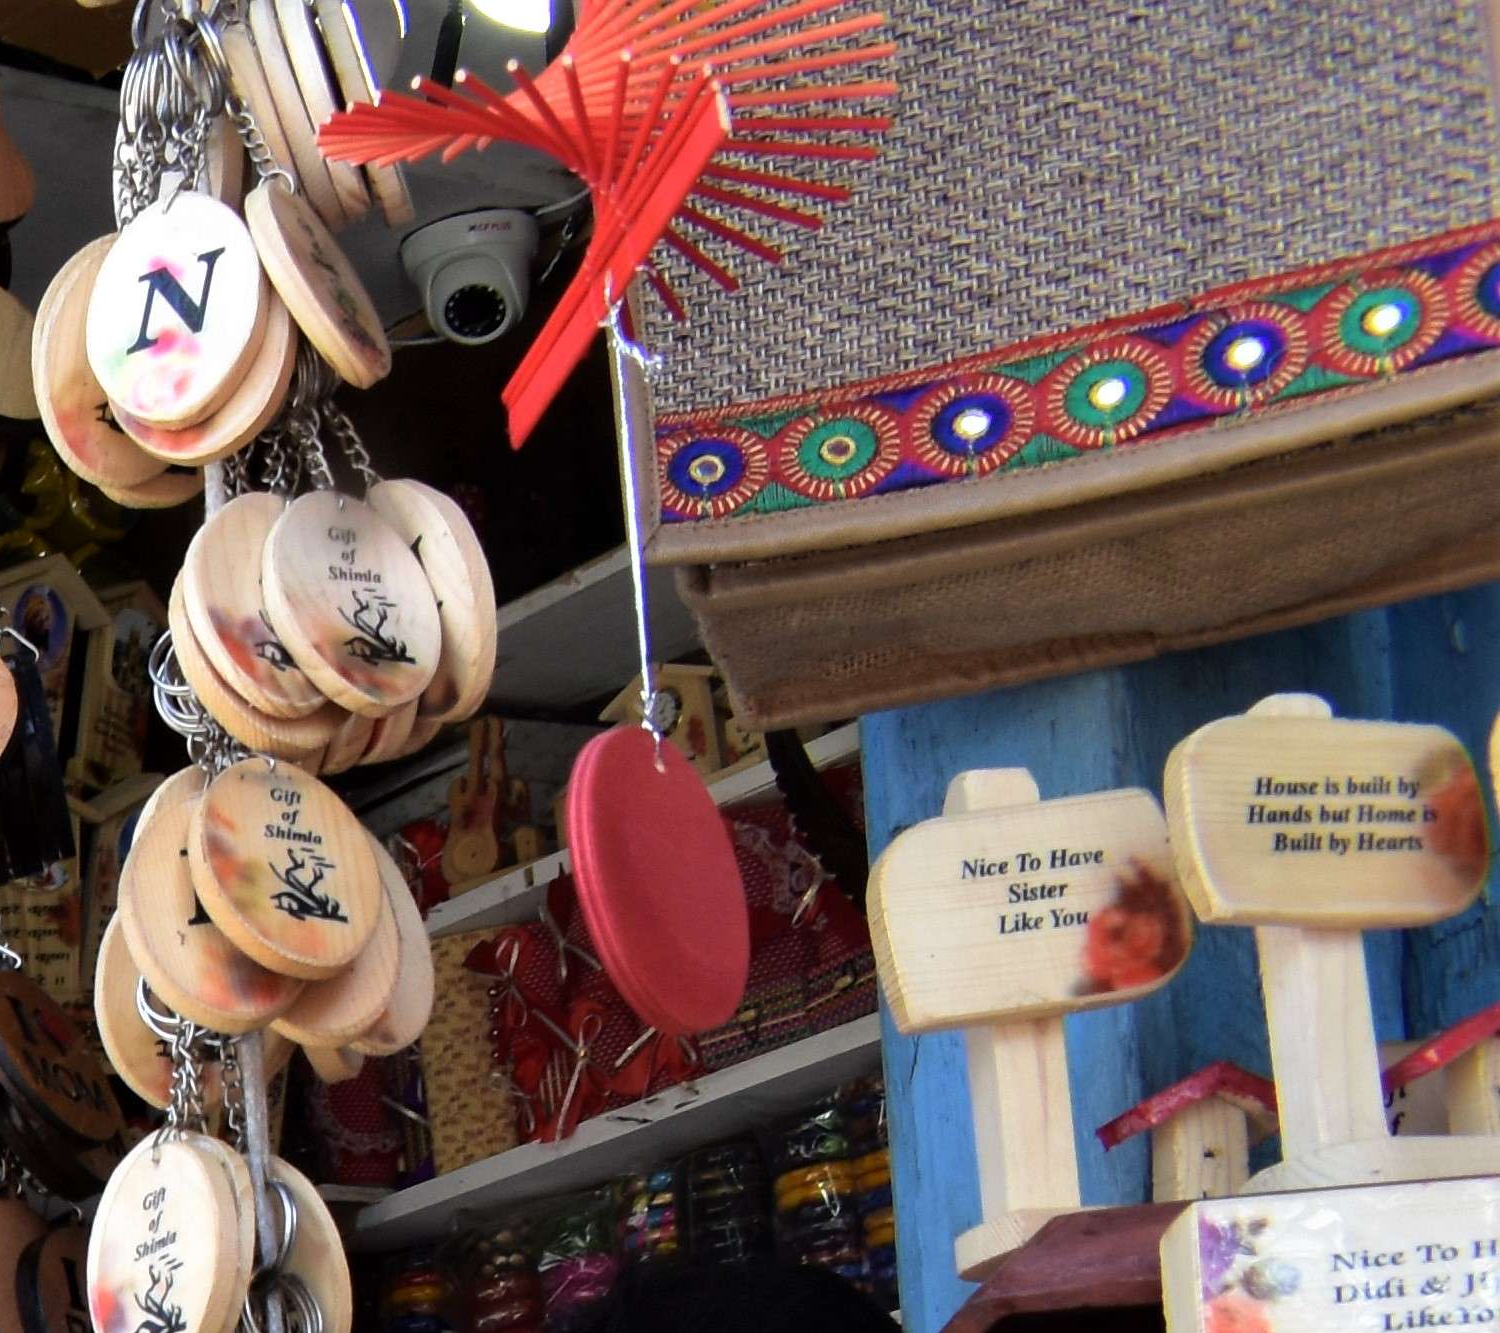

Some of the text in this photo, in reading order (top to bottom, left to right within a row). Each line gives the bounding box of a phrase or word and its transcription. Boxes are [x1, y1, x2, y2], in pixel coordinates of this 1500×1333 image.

[126, 246, 227, 356] N
[327, 527, 357, 543] Gift
[340, 549, 356, 564] of
[328, 567, 381, 584] Shimla
[269, 788, 302, 804] Gift
[1255, 776, 1419, 801] House is built by
[281, 809, 300, 826] of
[1248, 805, 1438, 825] Hands but Home is
[264, 824, 323, 845] Shimla
[1273, 832, 1424, 857] Built by Hearts
[961, 847, 1104, 880] Nice To Have
[1008, 881, 1068, 904] Sister
[999, 908, 1089, 935] Like You
[142, 1187, 166, 1211] Gift
[149, 1211, 163, 1231] of
[134, 1230, 177, 1262] Shimla
